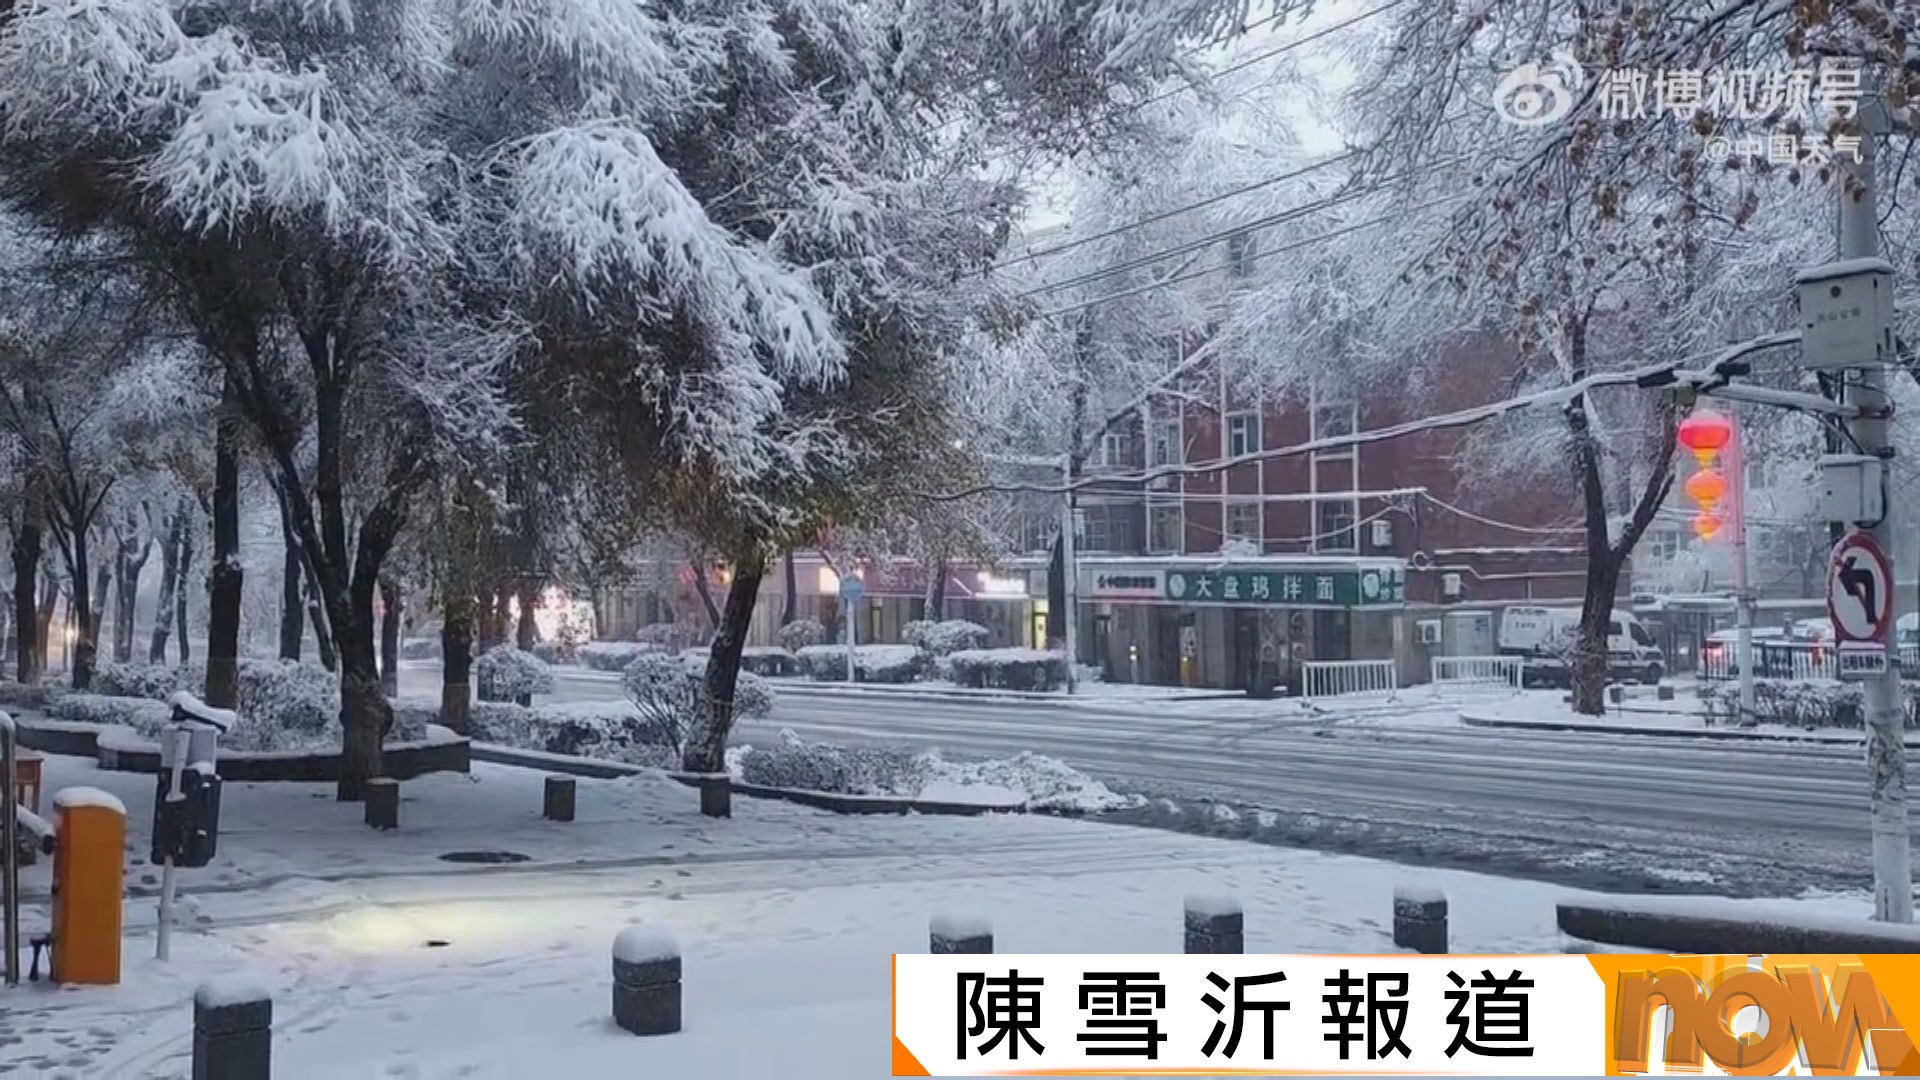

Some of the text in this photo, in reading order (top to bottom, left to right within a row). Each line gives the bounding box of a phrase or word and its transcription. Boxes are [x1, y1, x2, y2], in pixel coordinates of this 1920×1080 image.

[1196, 574, 1335, 601] 大盘鸡拌面
